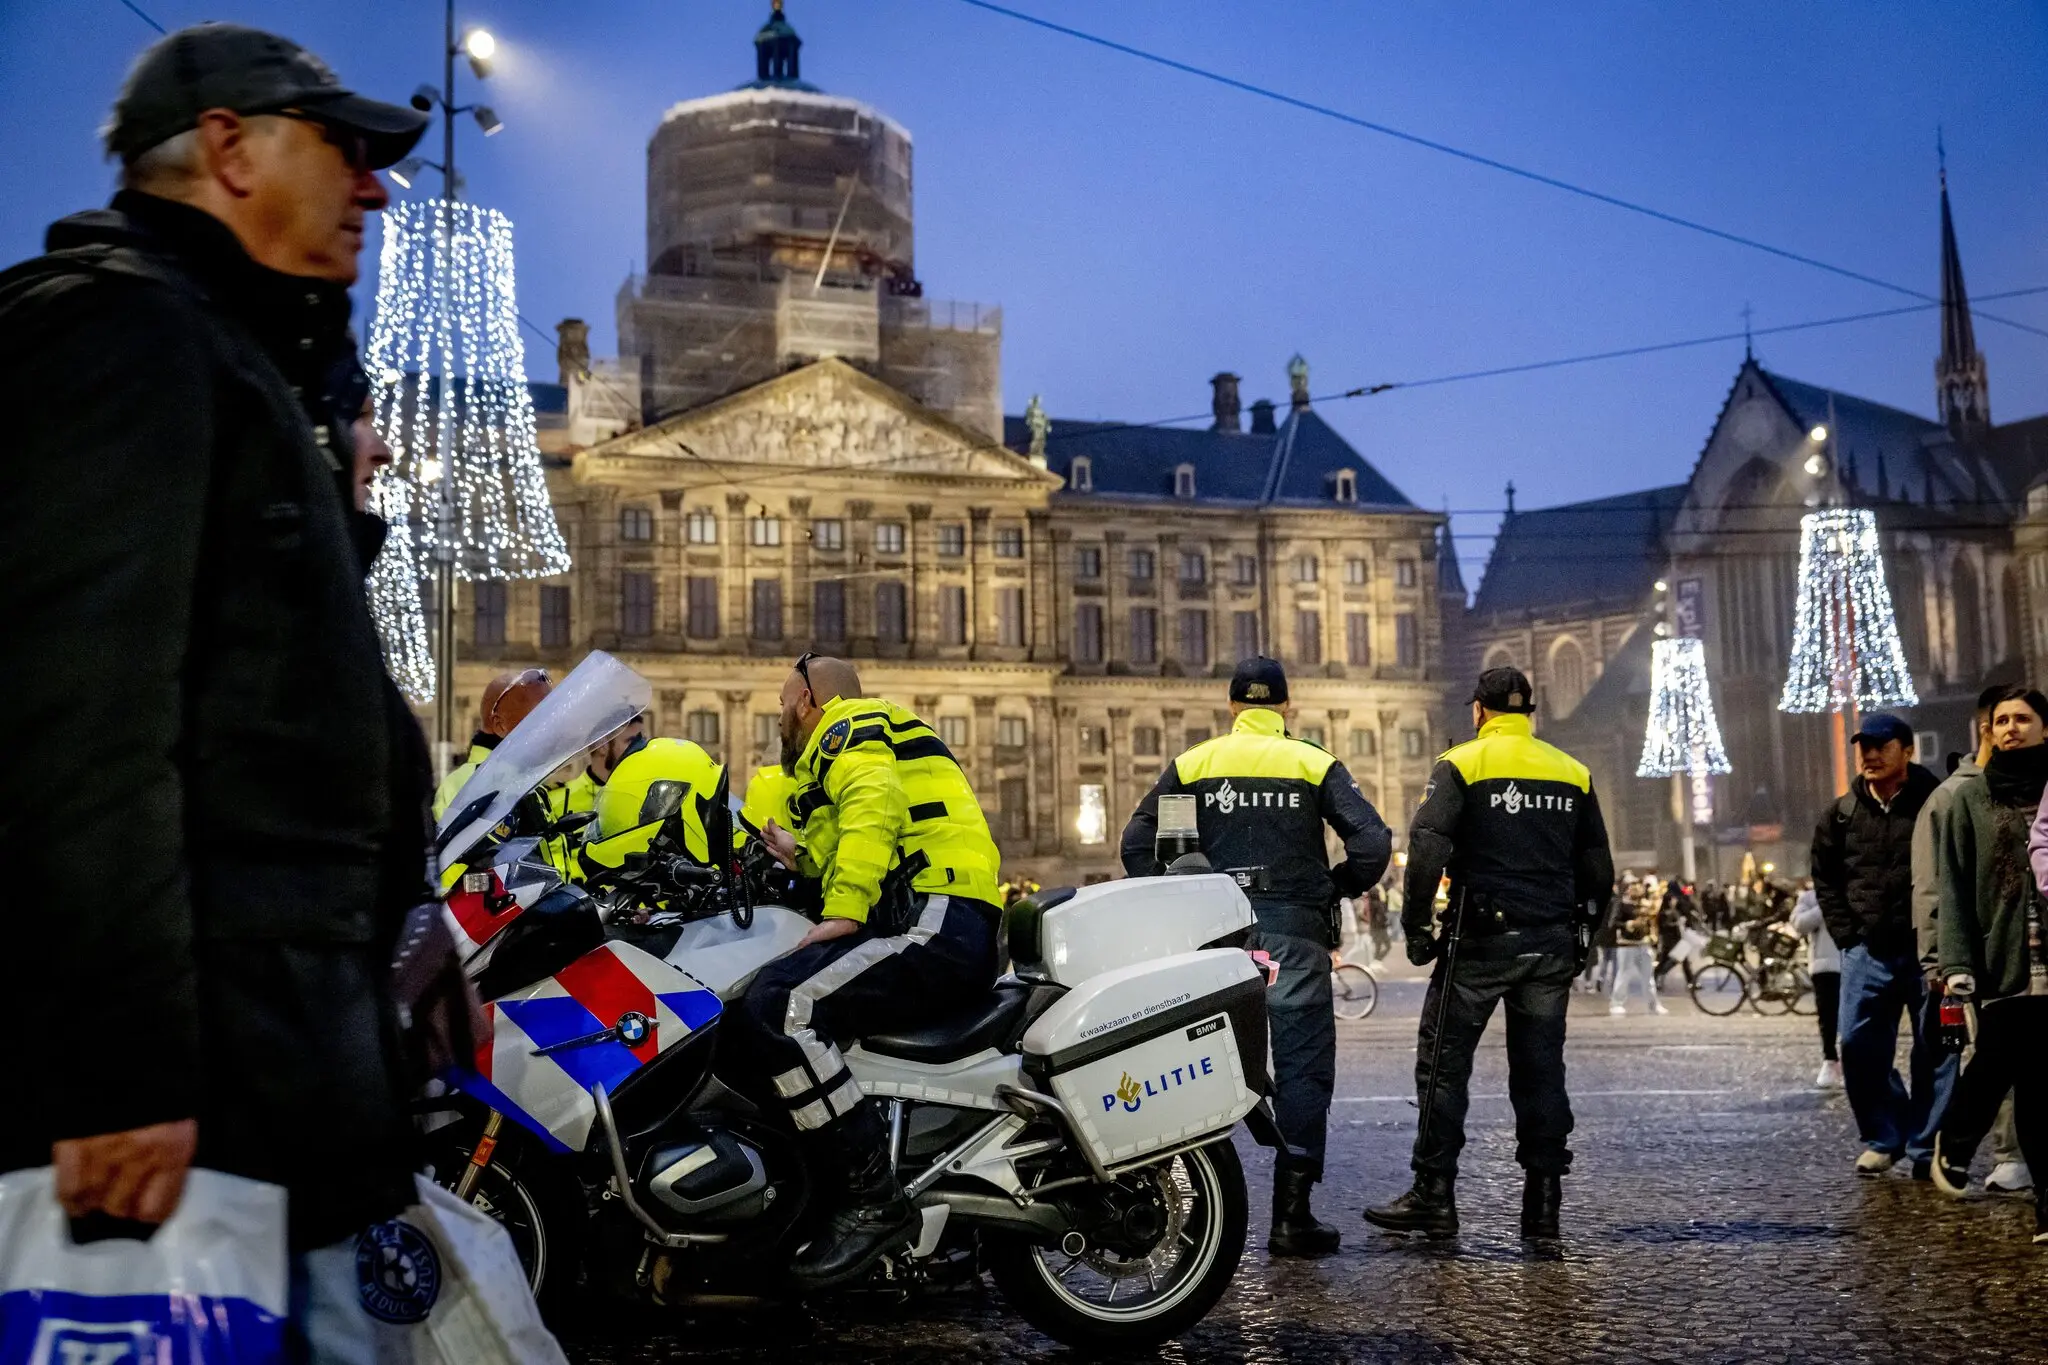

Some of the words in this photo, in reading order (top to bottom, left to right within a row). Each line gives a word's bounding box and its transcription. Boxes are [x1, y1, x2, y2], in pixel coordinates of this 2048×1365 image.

[1205, 790, 1300, 814] POLITIE
[1490, 792, 1574, 815] POLITIE
[1132, 1010, 1143, 1021] en
[1196, 1022, 1217, 1037] BMW
[1102, 1056, 1214, 1113] POLITIE
